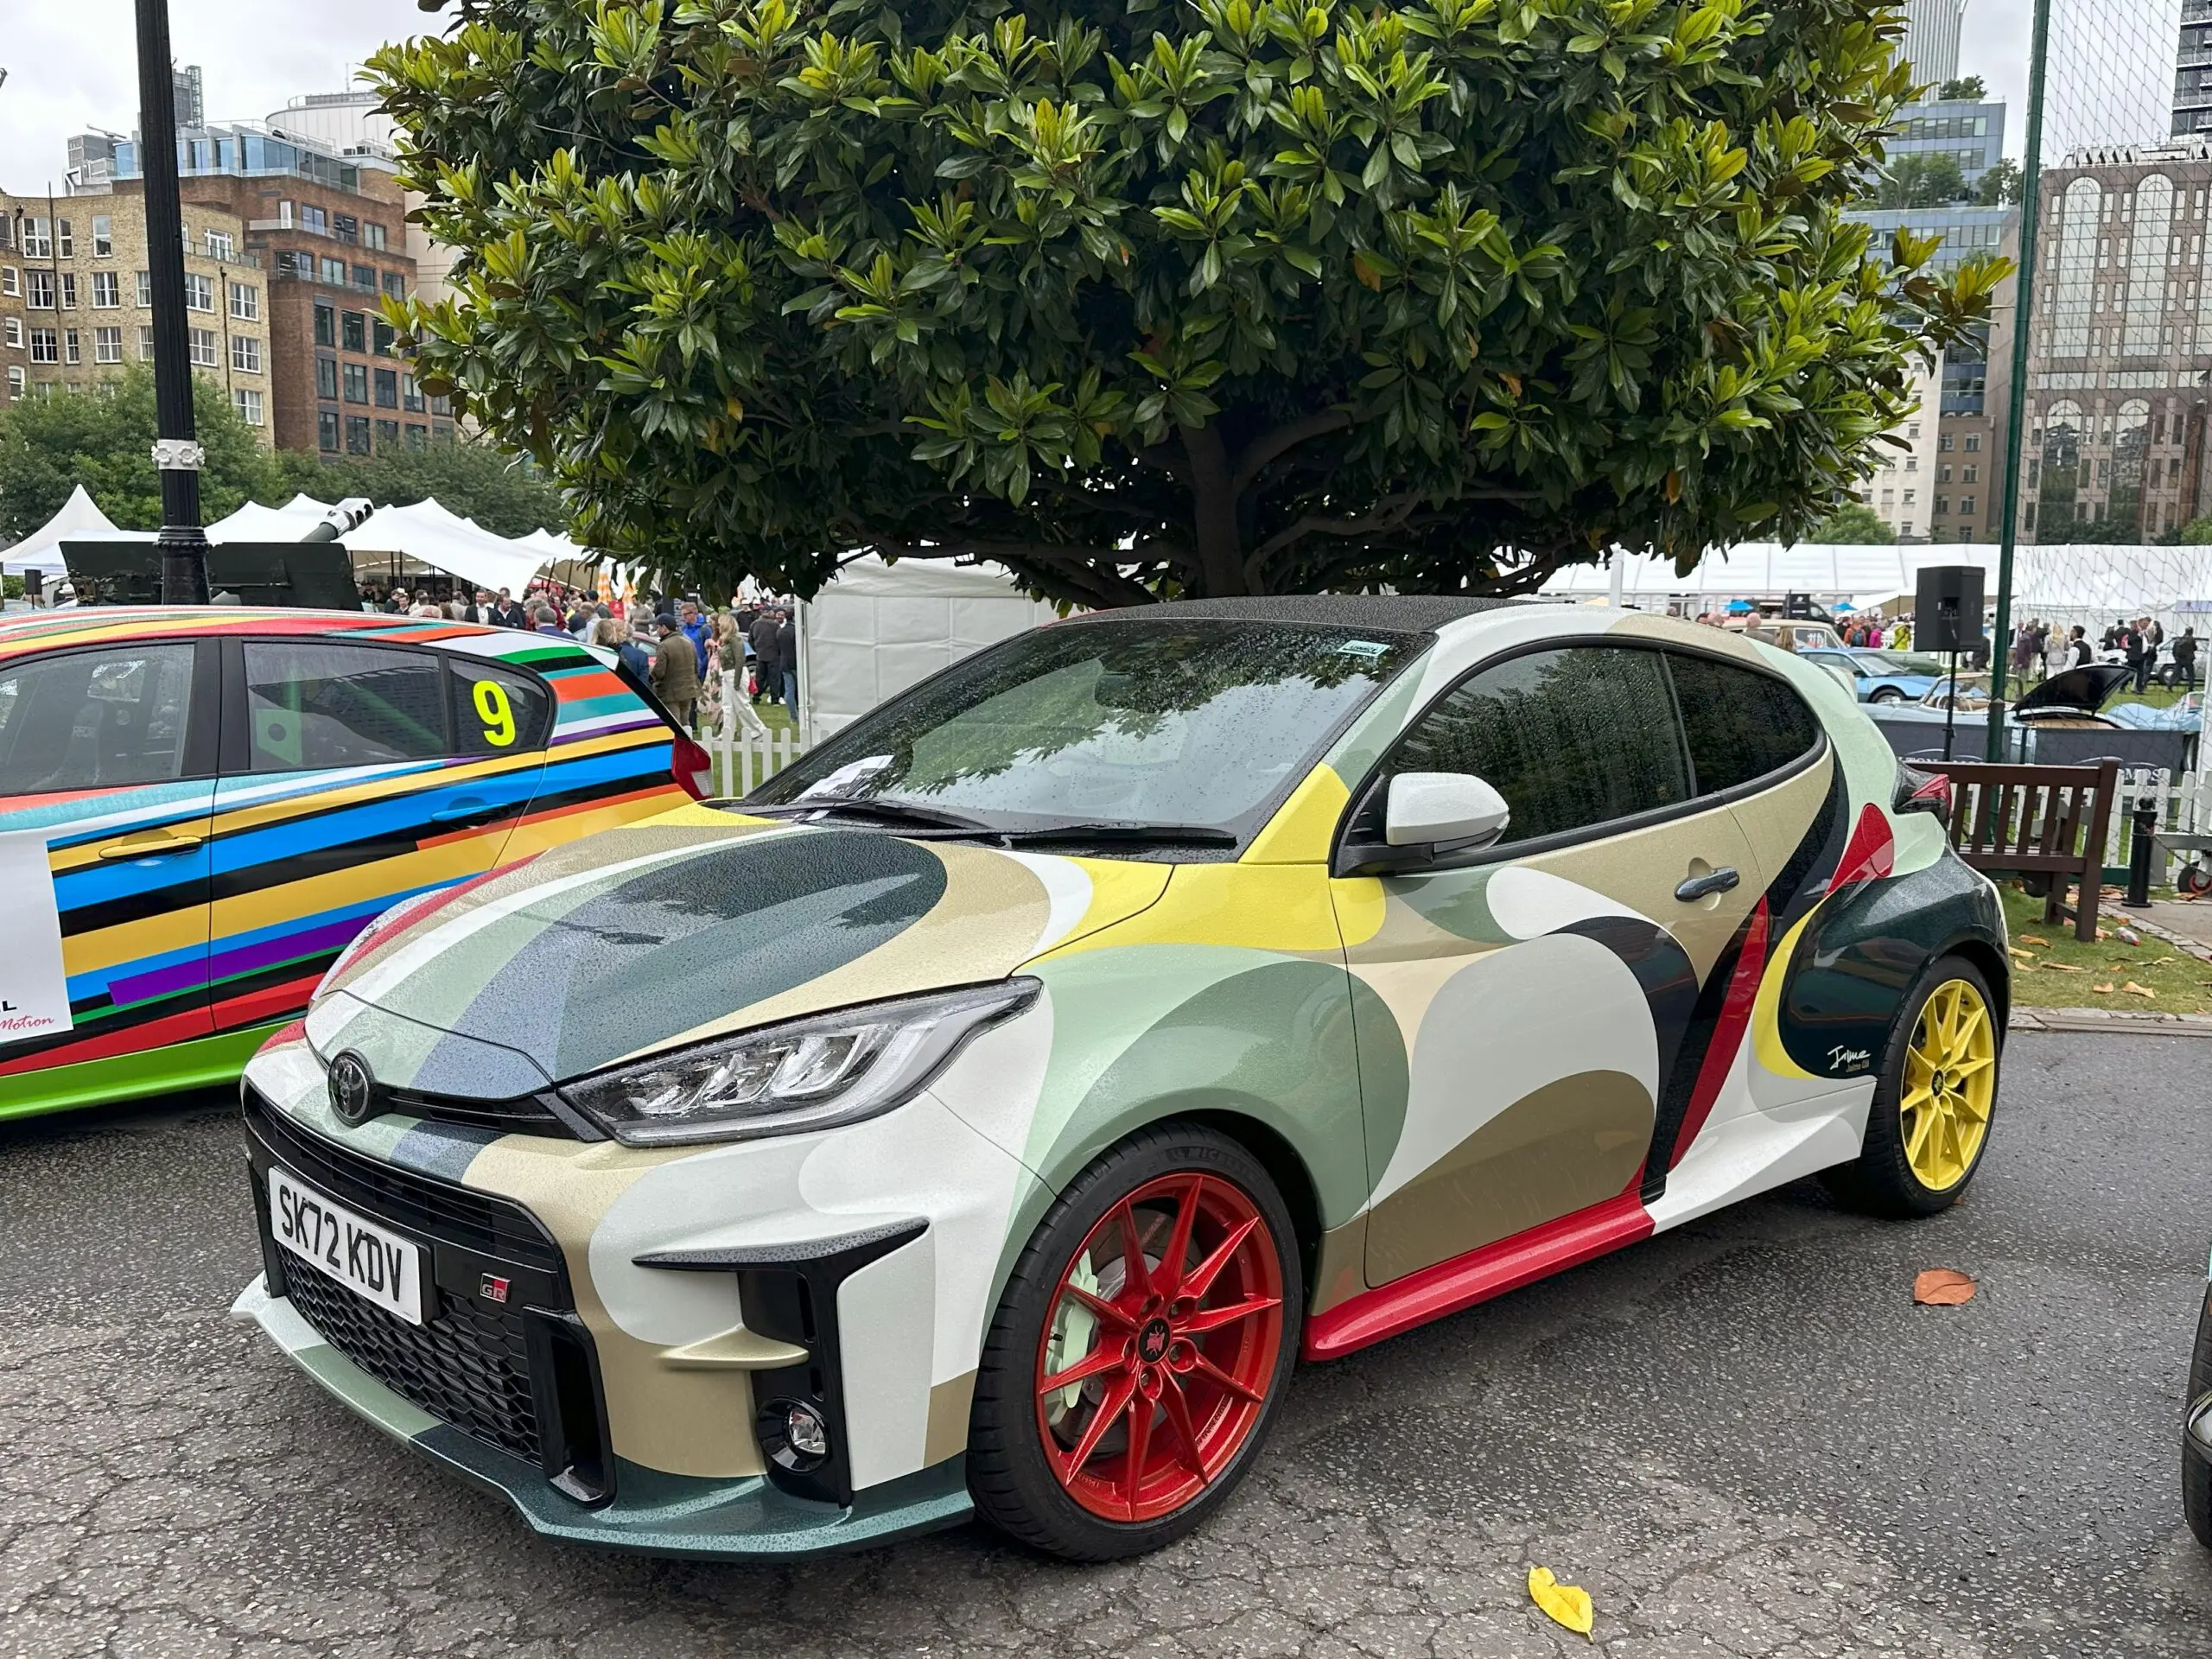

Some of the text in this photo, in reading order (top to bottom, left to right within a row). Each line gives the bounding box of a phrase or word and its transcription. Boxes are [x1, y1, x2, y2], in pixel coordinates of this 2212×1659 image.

[472, 680, 516, 747] 9
[0, 1014, 54, 1031] Motion
[279, 1184, 403, 1303] SK72 KDV
[481, 1283, 506, 1300] GR
